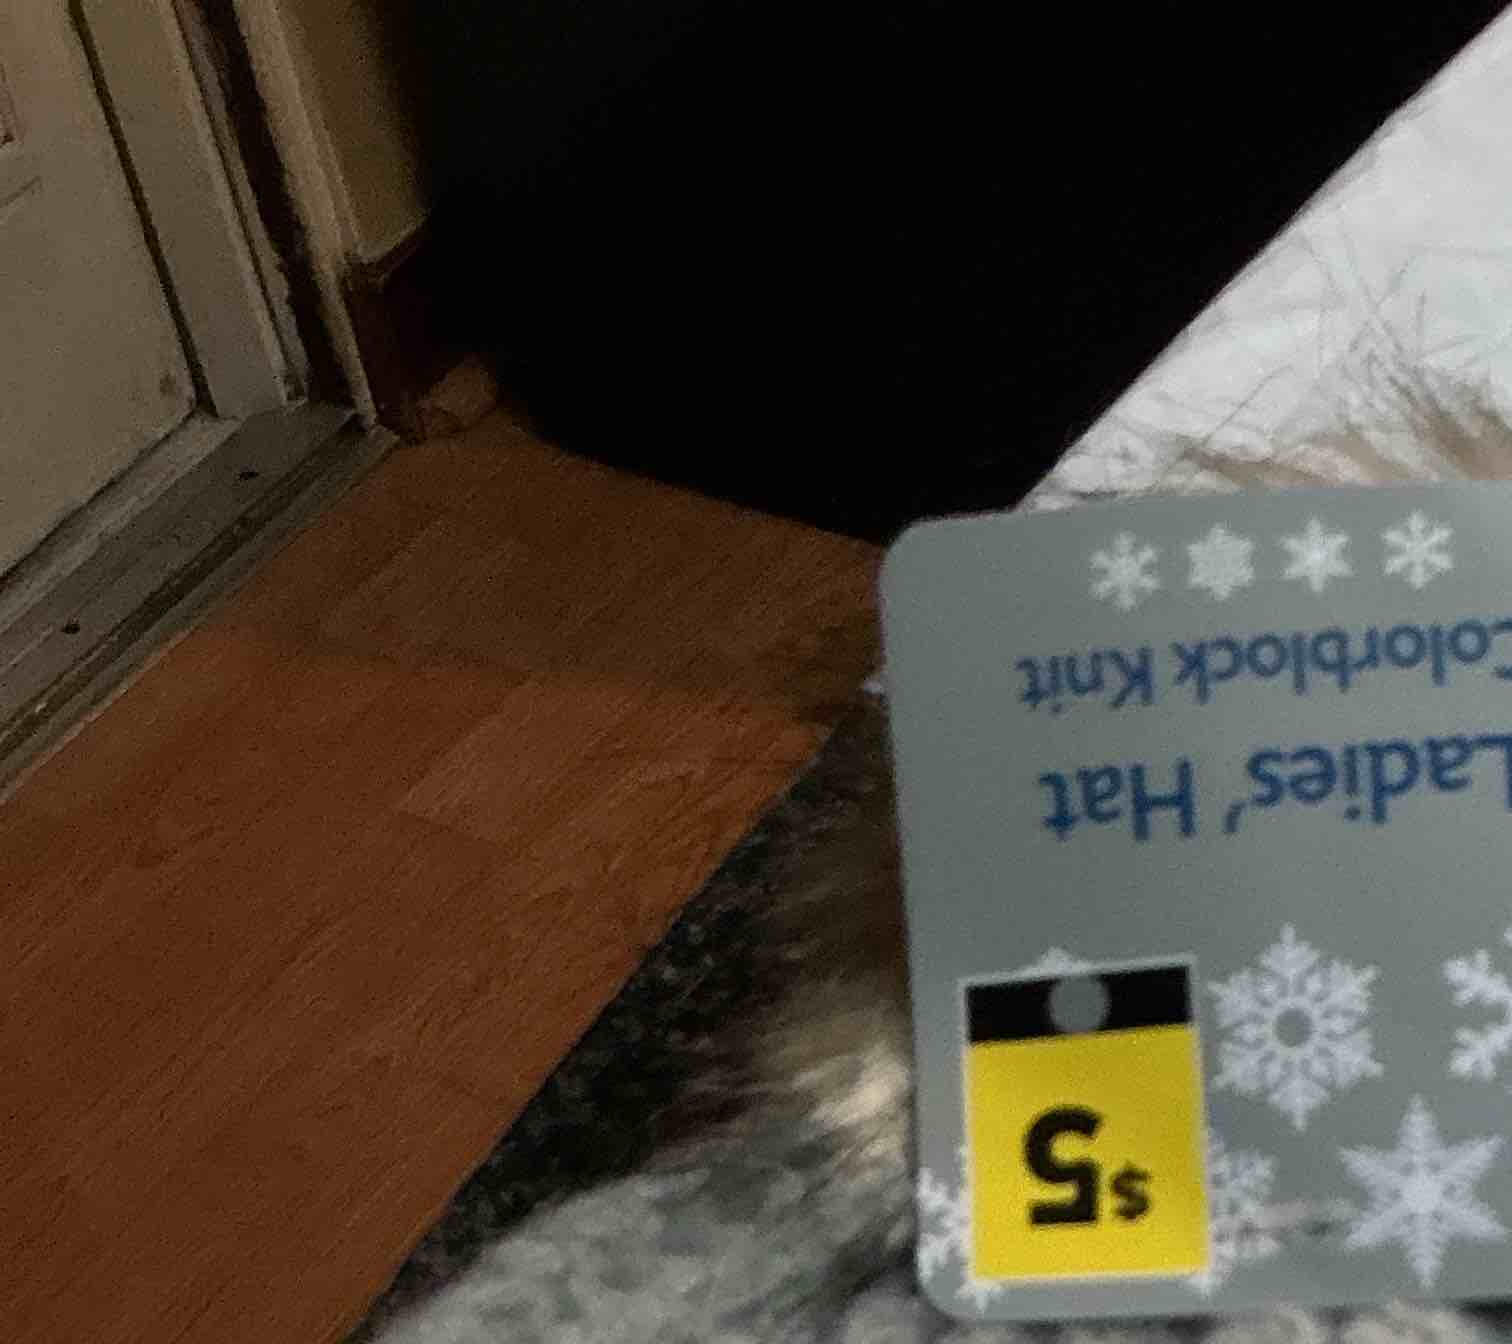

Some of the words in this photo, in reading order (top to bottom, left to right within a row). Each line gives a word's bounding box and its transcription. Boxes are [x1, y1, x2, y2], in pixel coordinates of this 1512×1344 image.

[1016, 640, 1156, 713] Knit
[1037, 759, 1197, 841] Hat
[1022, 1104, 1152, 1227] $5
